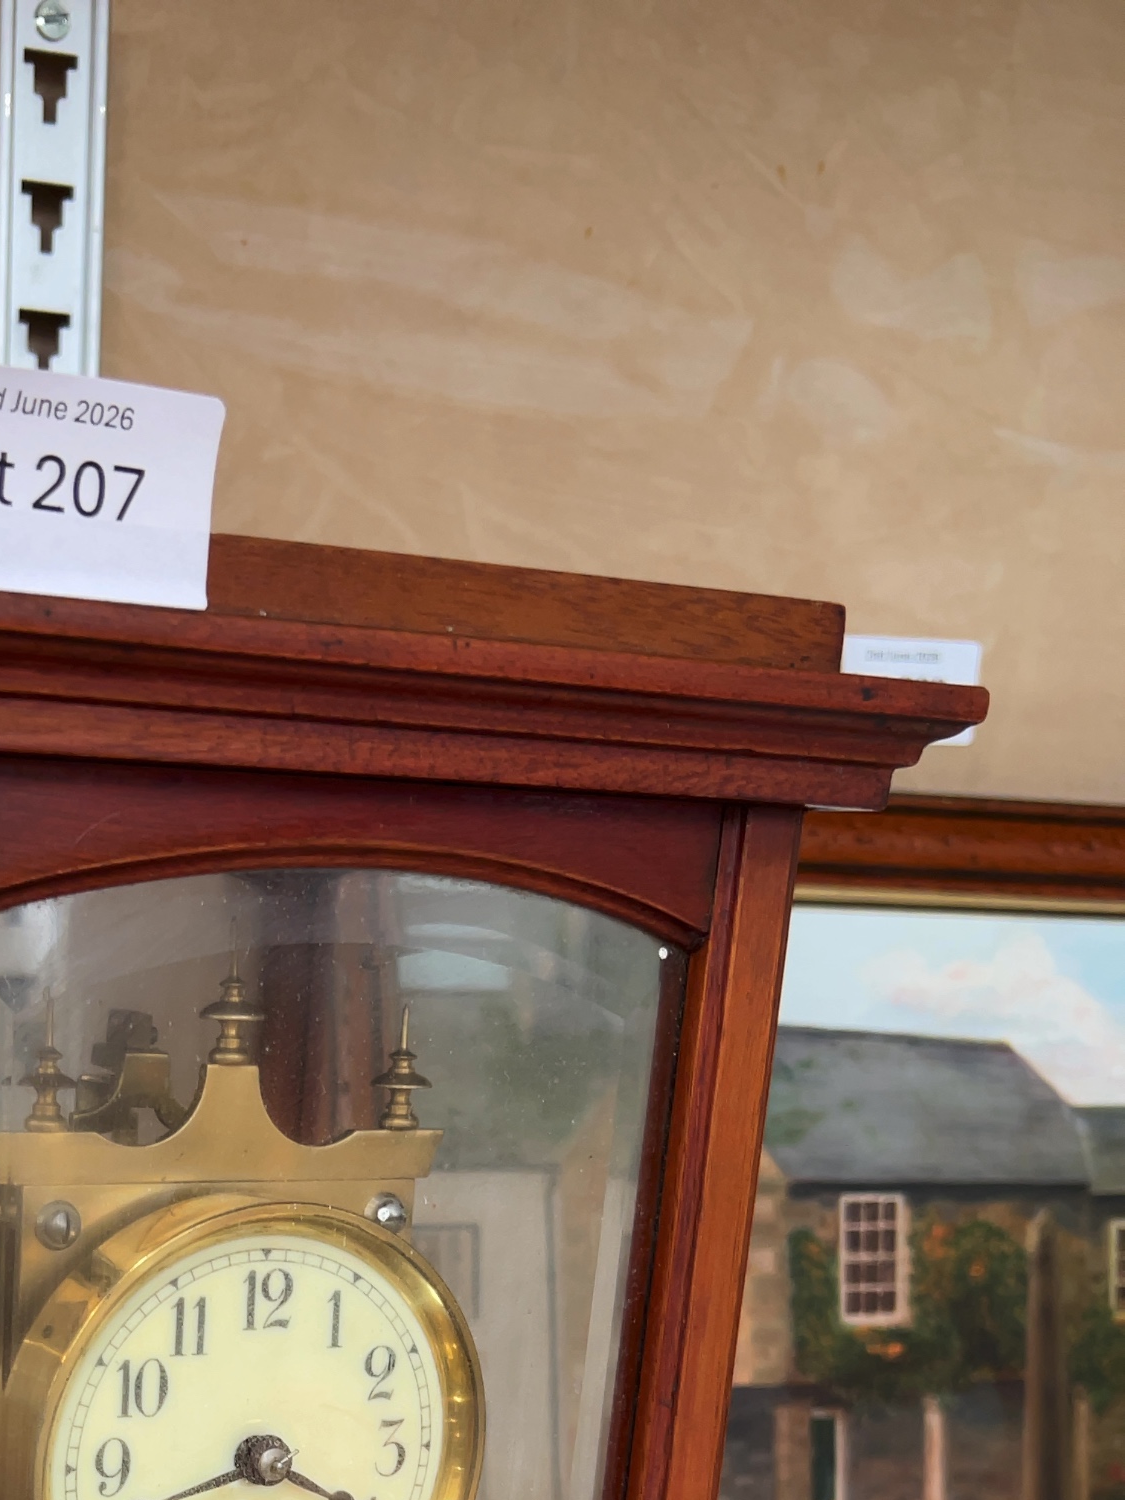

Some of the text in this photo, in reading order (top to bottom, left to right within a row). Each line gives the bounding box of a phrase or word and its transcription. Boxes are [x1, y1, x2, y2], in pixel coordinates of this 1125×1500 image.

[11, 390, 68, 420] June
[75, 400, 135, 430] 2026
[32, 455, 146, 522] 207
[169, 1297, 208, 1357] 11
[243, 1269, 293, 1331] 12
[326, 1290, 342, 1349] 1
[117, 1358, 168, 1419] 10
[365, 1345, 396, 1401] 2
[95, 1438, 130, 1496] 9
[376, 1419, 405, 1477] 3
